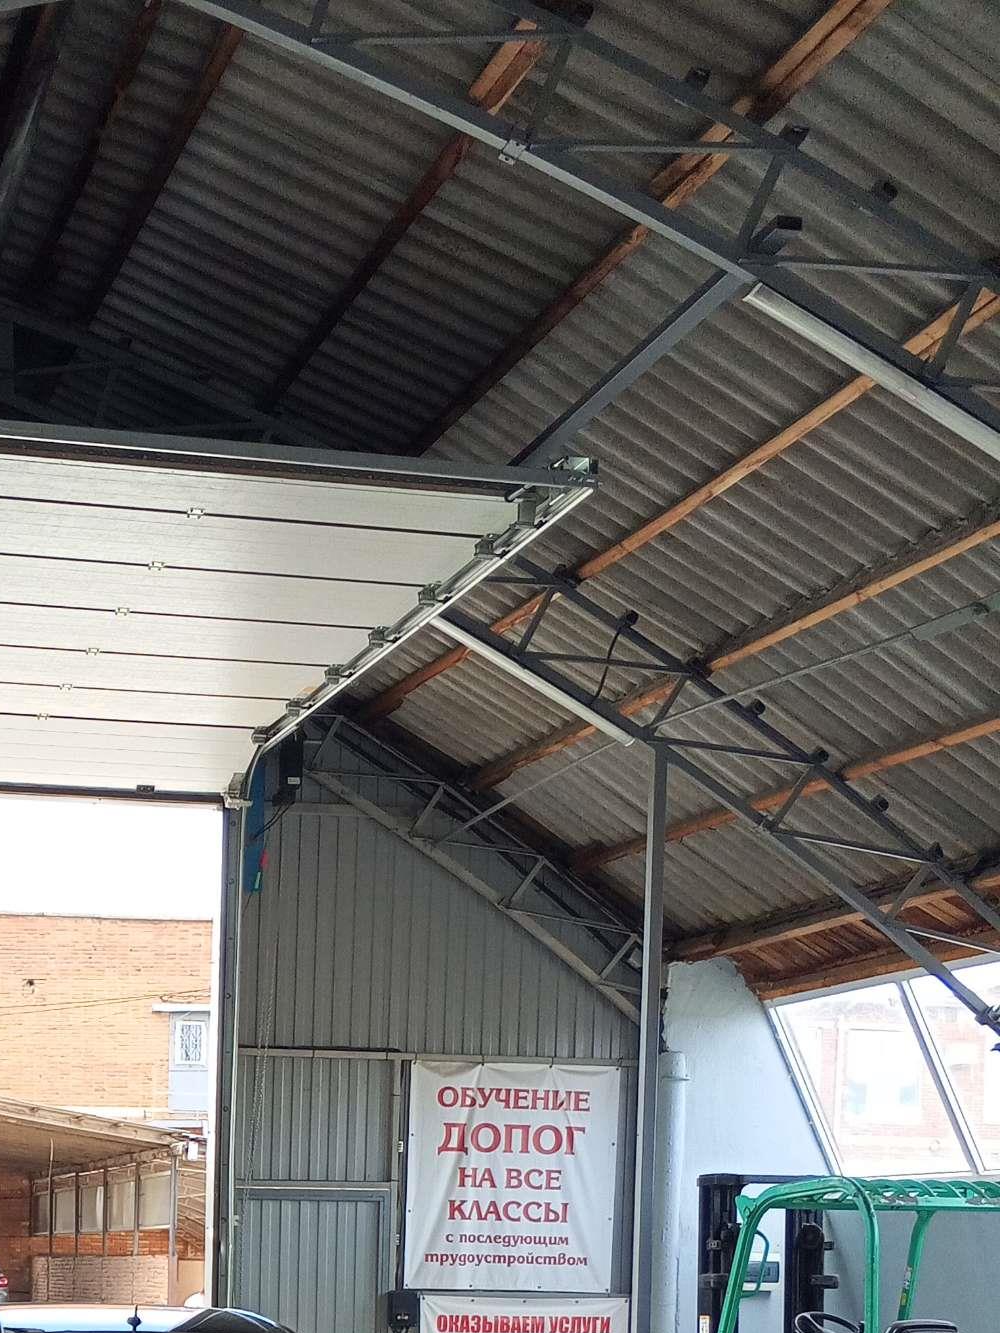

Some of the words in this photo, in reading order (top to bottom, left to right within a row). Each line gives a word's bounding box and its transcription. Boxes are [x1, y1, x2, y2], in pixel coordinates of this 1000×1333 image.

[437, 1086, 591, 1112] ОБУЧЕНИЕ
[437, 1122, 586, 1156] ДОПОГ
[458, 1167, 497, 1189] НА
[504, 1168, 562, 1191] ВСЕ
[447, 1199, 569, 1224] КЛАССЫ
[445, 1233, 454, 1243] с
[459, 1233, 569, 1247] последующим
[424, 1252, 588, 1267] трудоустройством
[436, 1314, 545, 1333] ОКАЗЫВАЕМ
